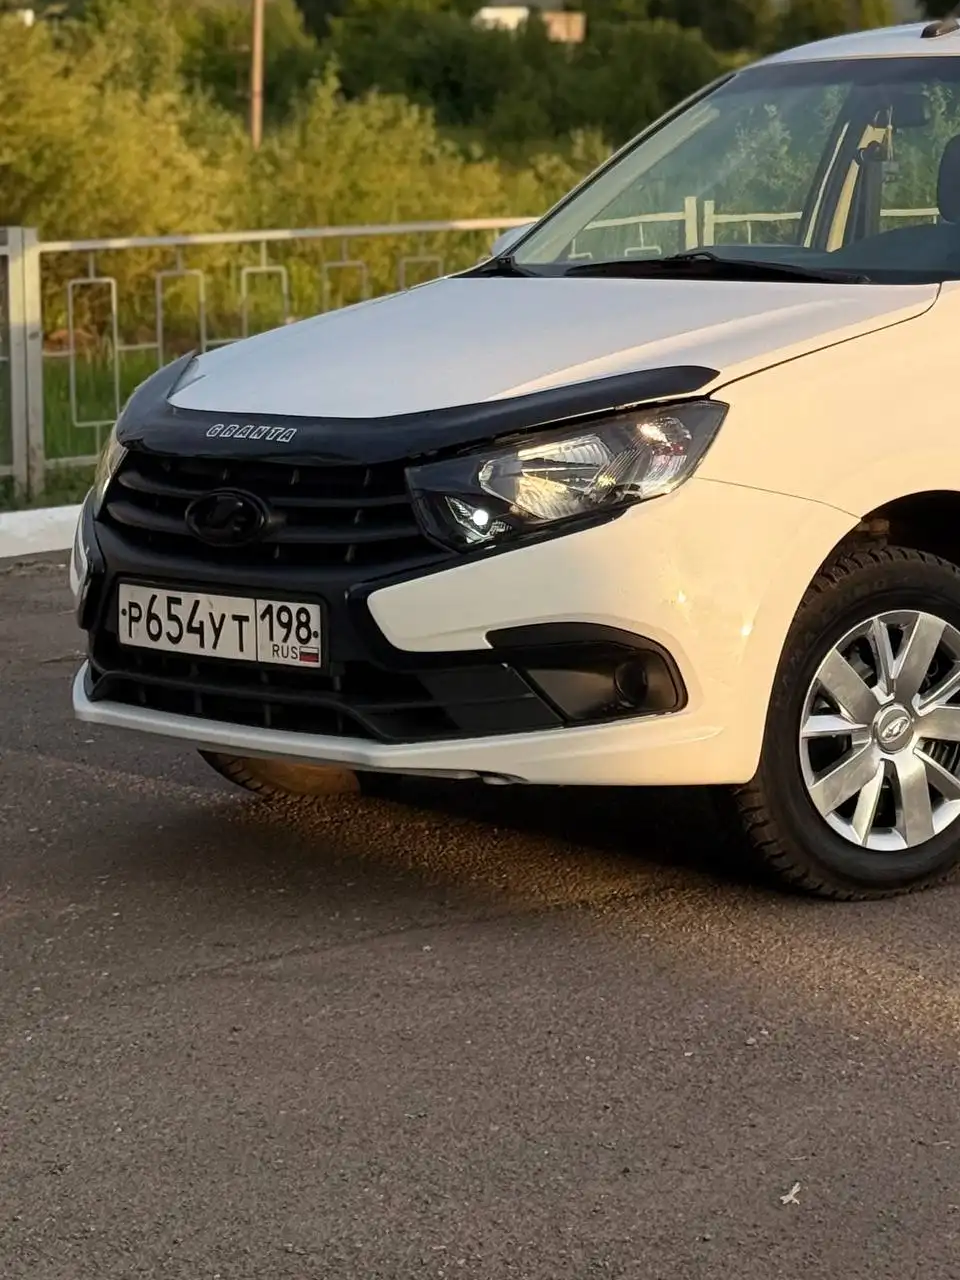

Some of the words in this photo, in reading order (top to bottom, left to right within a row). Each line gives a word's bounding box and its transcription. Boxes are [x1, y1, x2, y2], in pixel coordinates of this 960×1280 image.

[128, 594, 250, 653] Р654УТ
[259, 603, 312, 645] 198
[272, 643, 299, 660] RUS
